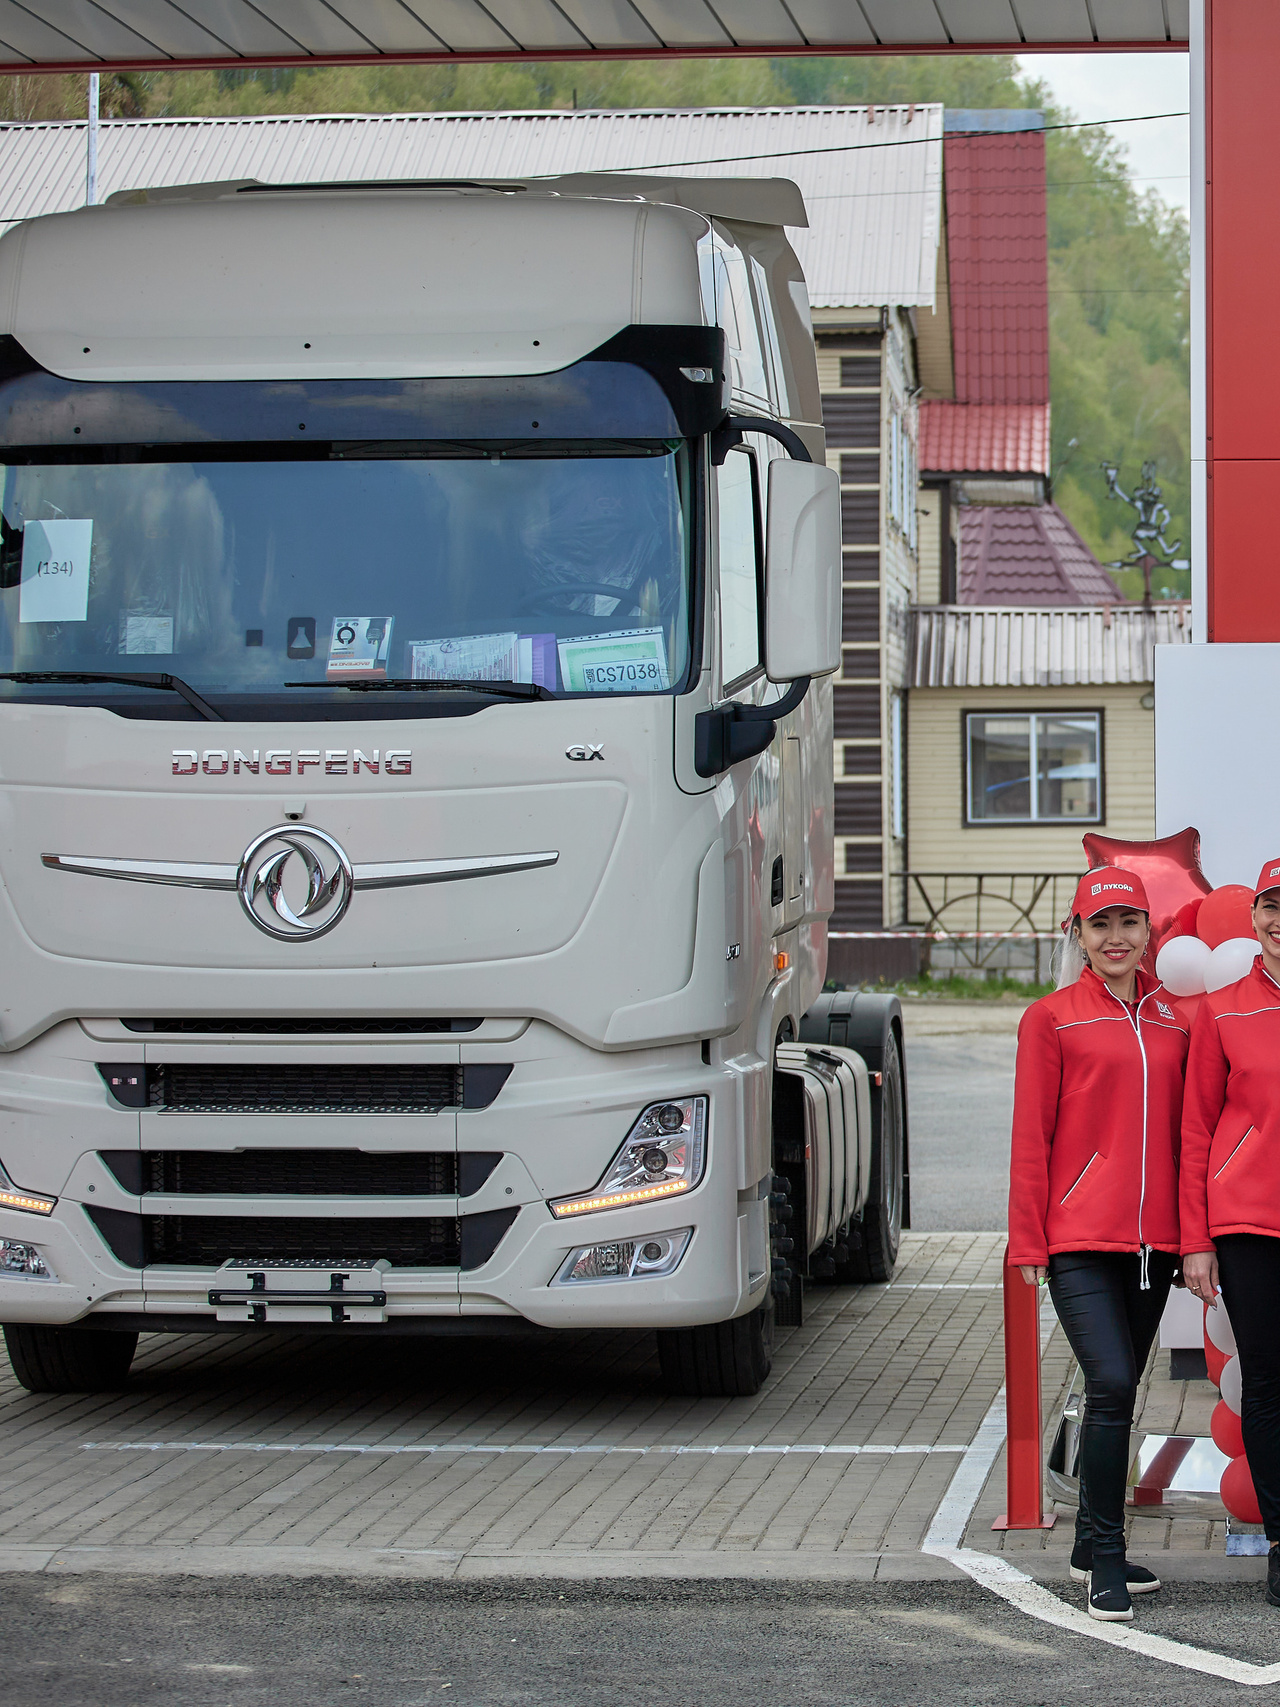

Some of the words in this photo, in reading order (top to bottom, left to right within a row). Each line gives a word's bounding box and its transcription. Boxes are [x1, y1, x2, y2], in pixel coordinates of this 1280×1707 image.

[37, 561, 73, 577] (134)
[565, 743, 605, 761] GX
[172, 749, 412, 775] DONGFENG
[1103, 883, 1133, 893] ЛУКОЙЛ
